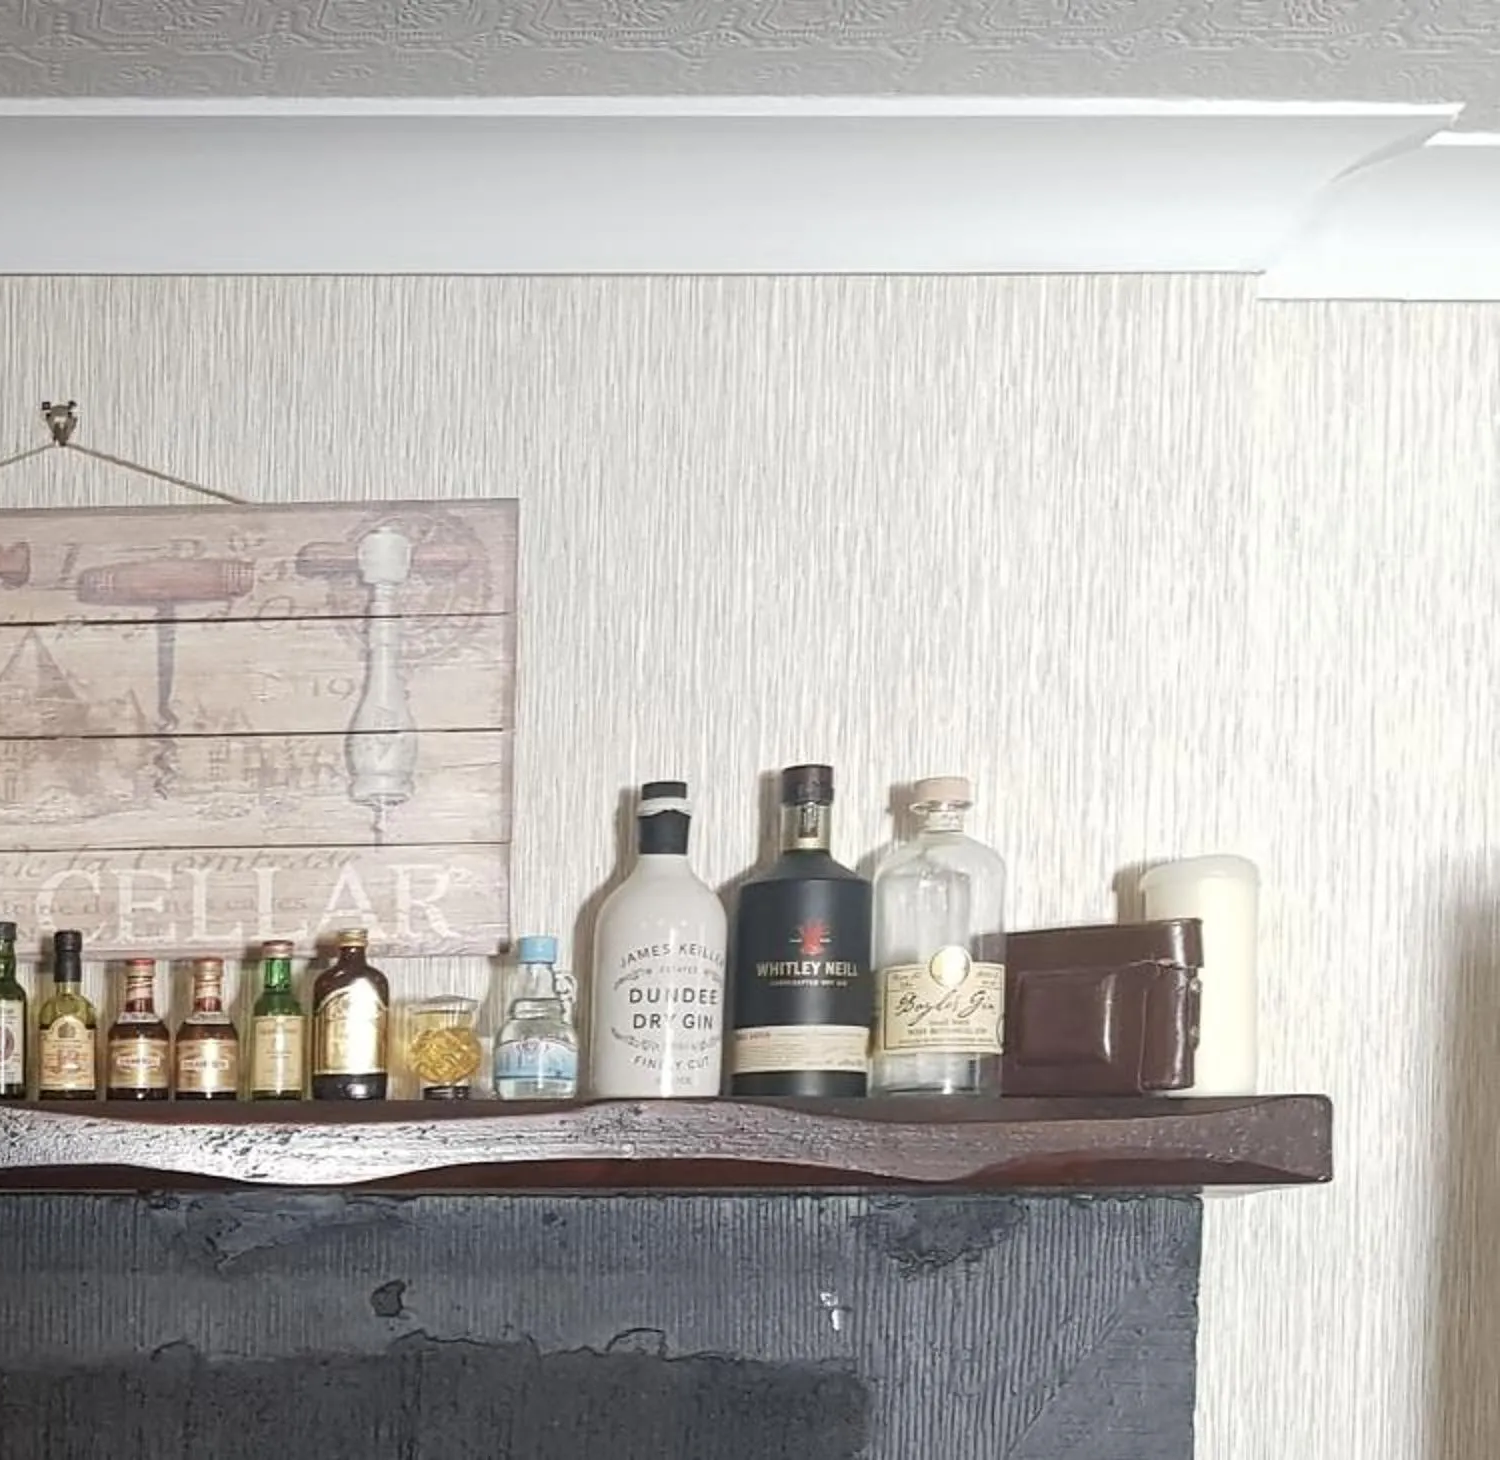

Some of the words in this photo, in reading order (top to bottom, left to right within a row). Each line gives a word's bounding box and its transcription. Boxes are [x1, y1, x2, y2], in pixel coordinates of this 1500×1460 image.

[35, 862, 464, 946] CELLAR
[756, 961, 821, 977] WHITLEY
[825, 961, 858, 977] NEILL
[629, 987, 718, 1005] DUNDEE
[682, 1013, 714, 1030] GIN
